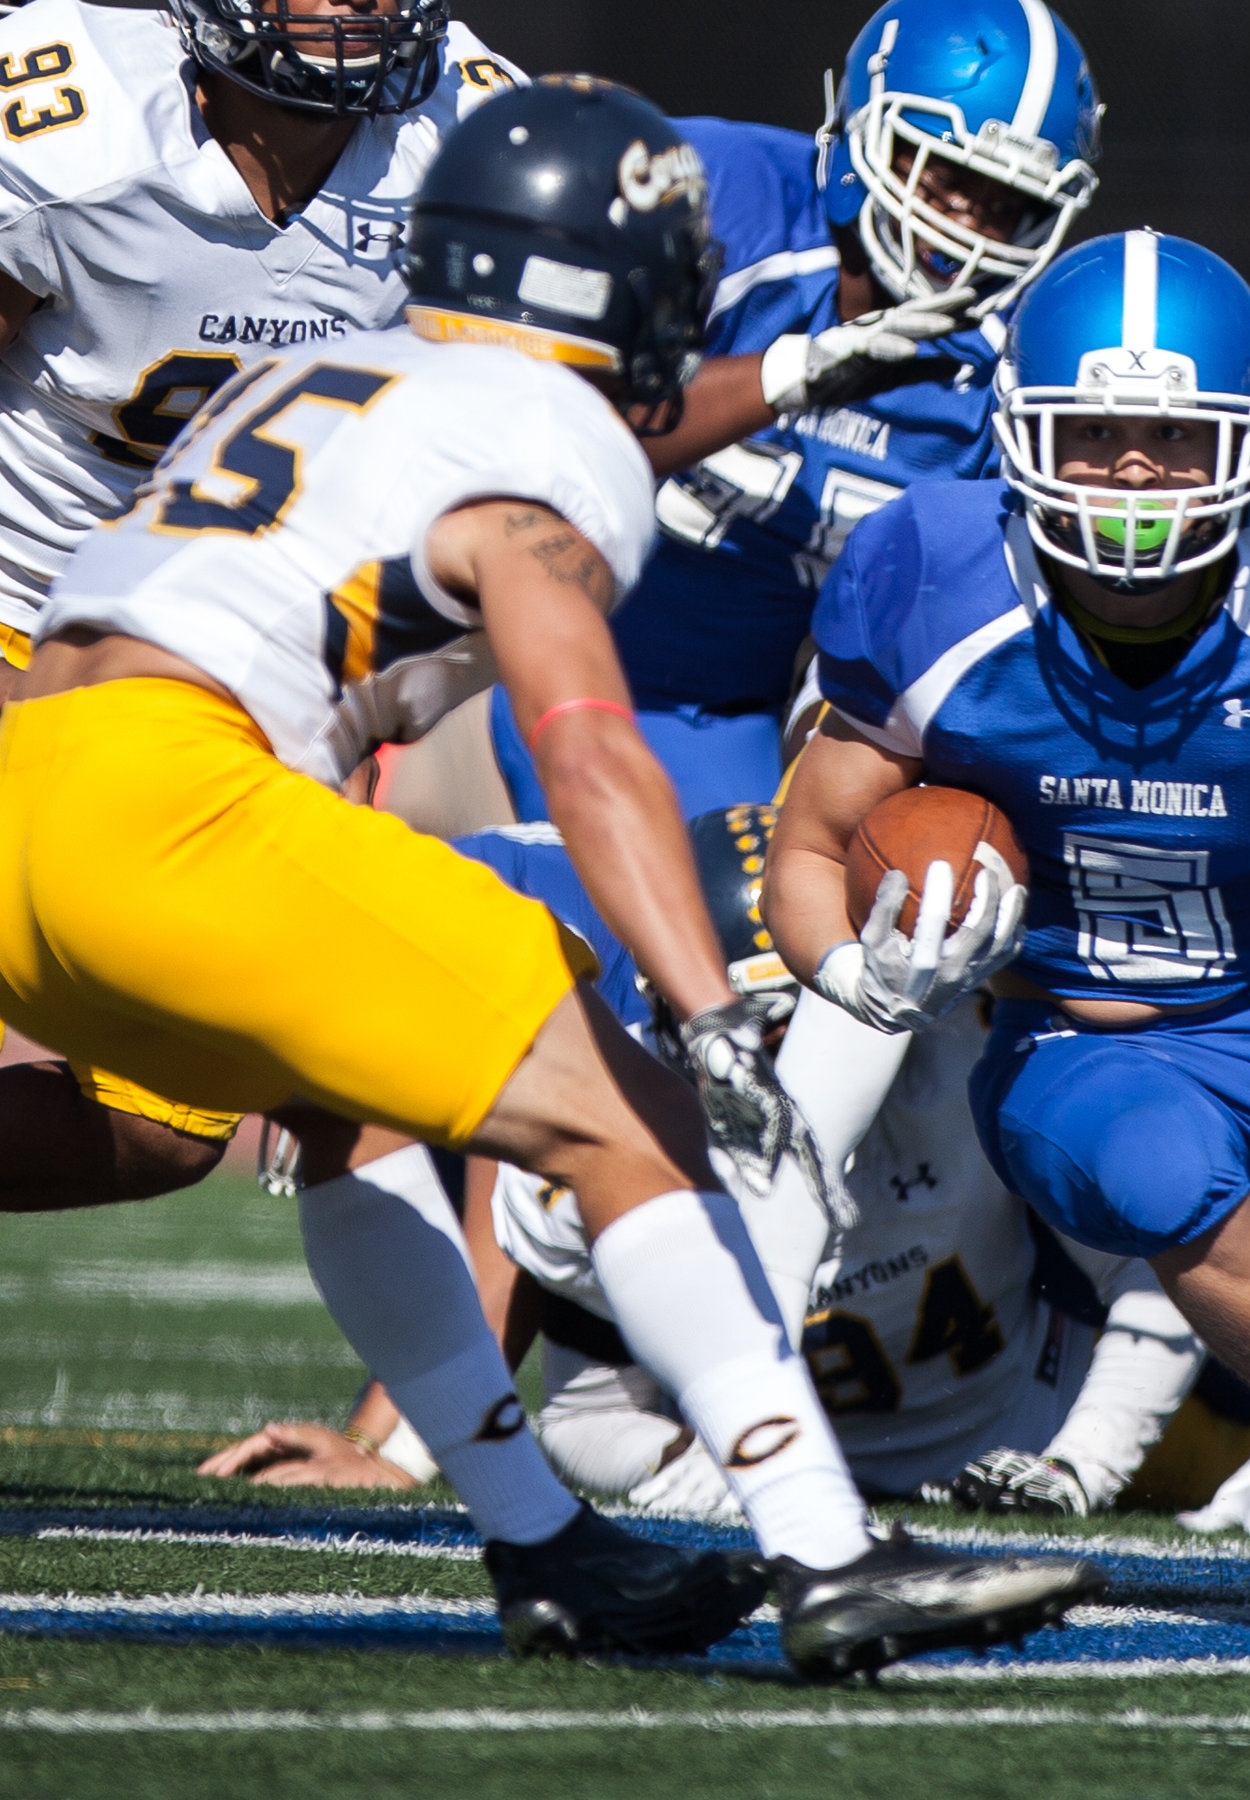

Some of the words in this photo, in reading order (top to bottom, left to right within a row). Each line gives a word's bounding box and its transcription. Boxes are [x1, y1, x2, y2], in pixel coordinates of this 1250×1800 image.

[0, 40, 89, 143] 93
[199, 305, 347, 345] CANYONS
[1040, 775, 1124, 810] SANTA
[1130, 779, 1228, 817] MONICA
[1063, 832, 1237, 984] 5
[806, 1246, 928, 1312] ANYONS
